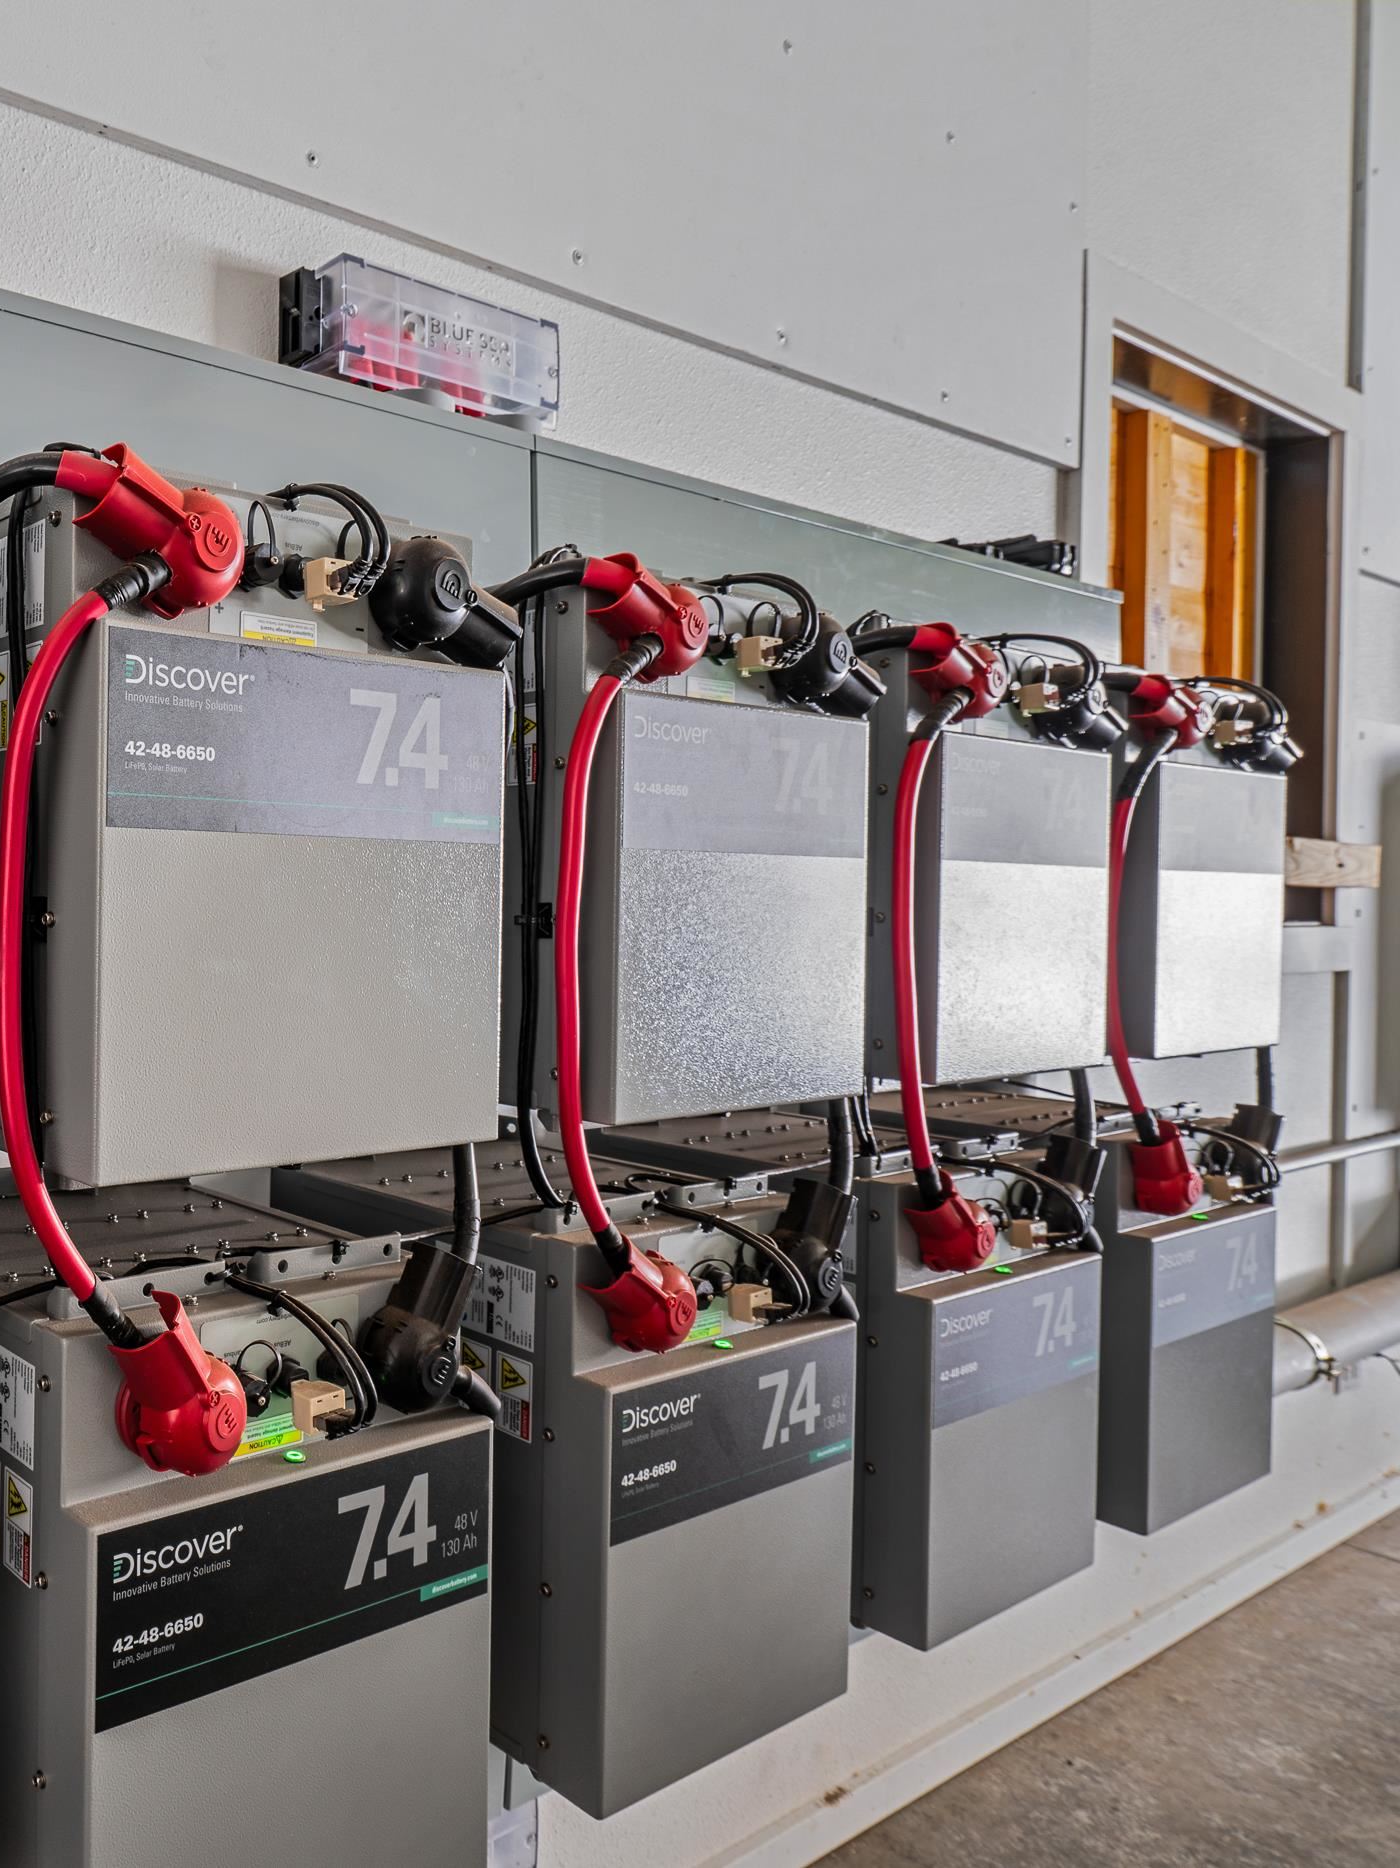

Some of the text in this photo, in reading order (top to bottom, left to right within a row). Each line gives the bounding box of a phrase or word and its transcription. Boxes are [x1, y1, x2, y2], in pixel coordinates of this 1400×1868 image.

[430, 318, 474, 343] BLUE
[125, 691, 243, 712] Innovative Battery Solutions
[350, 688, 448, 789] 7.4
[634, 716, 708, 745] Discover
[124, 741, 215, 761] 42-48-6650
[940, 1308, 993, 1338] Discover
[1033, 1286, 1077, 1357] 7.4
[759, 1361, 821, 1450] 7.4
[249, 1438, 277, 1450] CAUTION
[621, 1459, 677, 1487] 42-48-6650
[338, 1472, 437, 1590] 7.4
[454, 1509, 478, 1531] 48 V
[441, 1533, 477, 1558] 130 Ah
[113, 1560, 231, 1602] Innovative Battery Solutions
[112, 1613, 204, 1654] 42-48-6650
[136, 1649, 152, 1661] Solar
[154, 1642, 176, 1655] Battery
